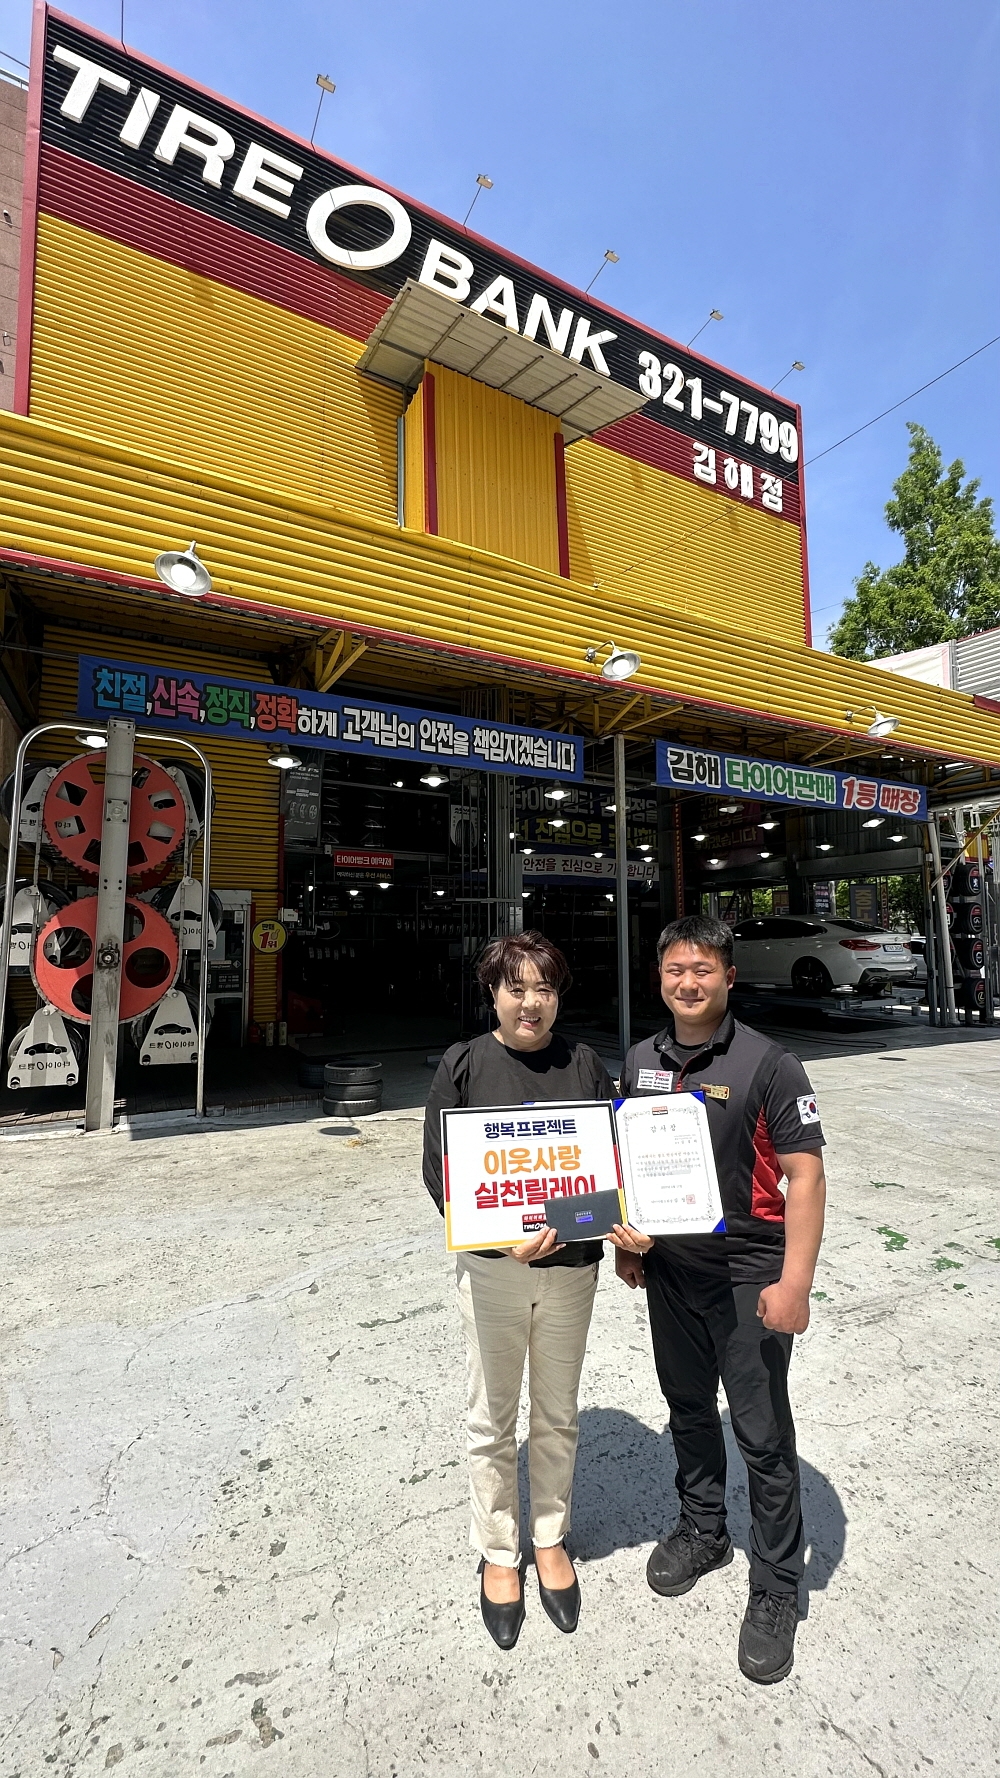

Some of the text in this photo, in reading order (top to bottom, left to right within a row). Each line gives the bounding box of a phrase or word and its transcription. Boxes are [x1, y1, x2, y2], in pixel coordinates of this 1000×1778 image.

[638, 350, 799, 464] 321-7799
[692, 442, 785, 513] 김해점
[342, 707, 415, 748] 고객님의
[419, 718, 470, 756] 안전을
[473, 726, 577, 773] 책임지겠습니다
[667, 747, 920, 815] 김해 타이어판매 1등 매장
[523, 857, 656, 879] 안전을 진심으로 기합니다
[259, 931, 278, 949] 1위
[483, 1118, 578, 1139] 행복프로젝트
[483, 1145, 582, 1175] 이웃사랑
[474, 1175, 597, 1209] 실천릴레이
